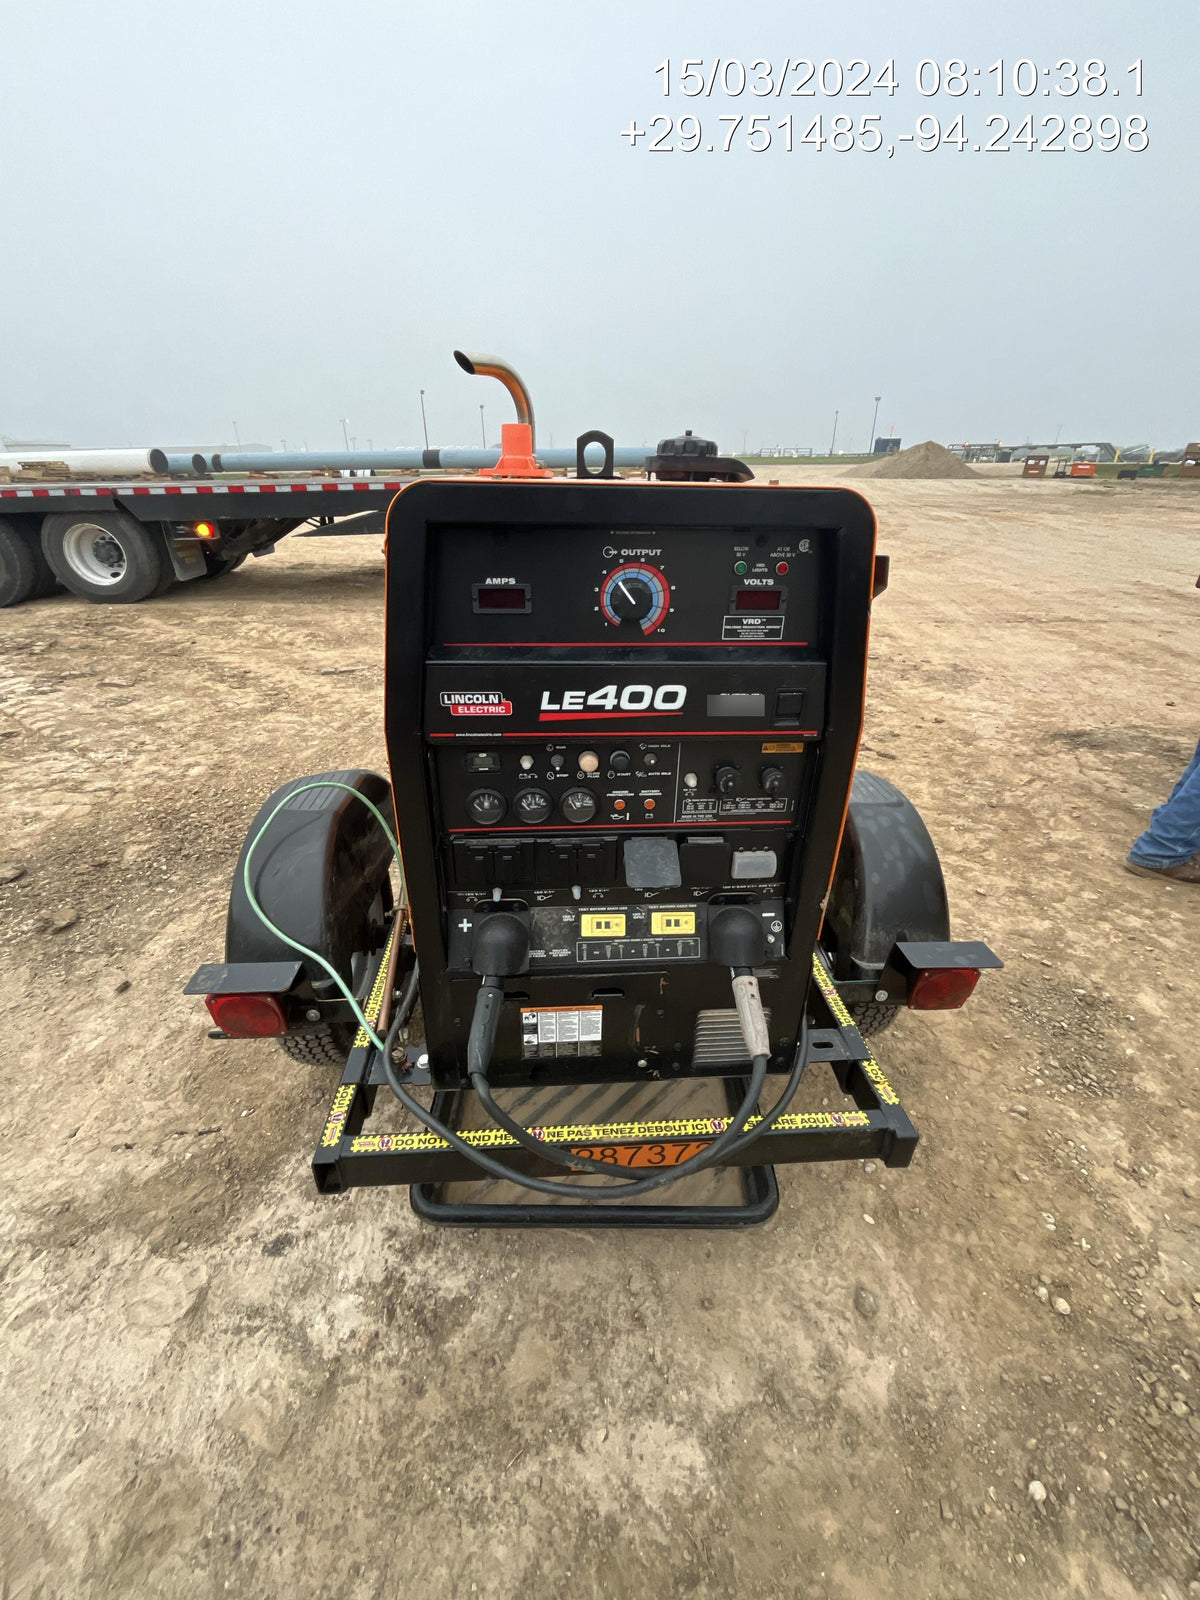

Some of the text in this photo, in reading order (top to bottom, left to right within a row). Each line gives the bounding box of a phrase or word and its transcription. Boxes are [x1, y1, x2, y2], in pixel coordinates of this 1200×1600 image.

[621, 548, 662, 556] OUTPUT
[485, 577, 516, 585] AMPS
[443, 694, 499, 704] LINCOLN
[540, 684, 687, 710] LE400
[458, 705, 506, 714] ELECTRIC
[547, 1122, 708, 1139] NE PAS TENEZ DEBOUT ICI
[394, 1138, 414, 1146] DO
[464, 1134, 491, 1142] AND
